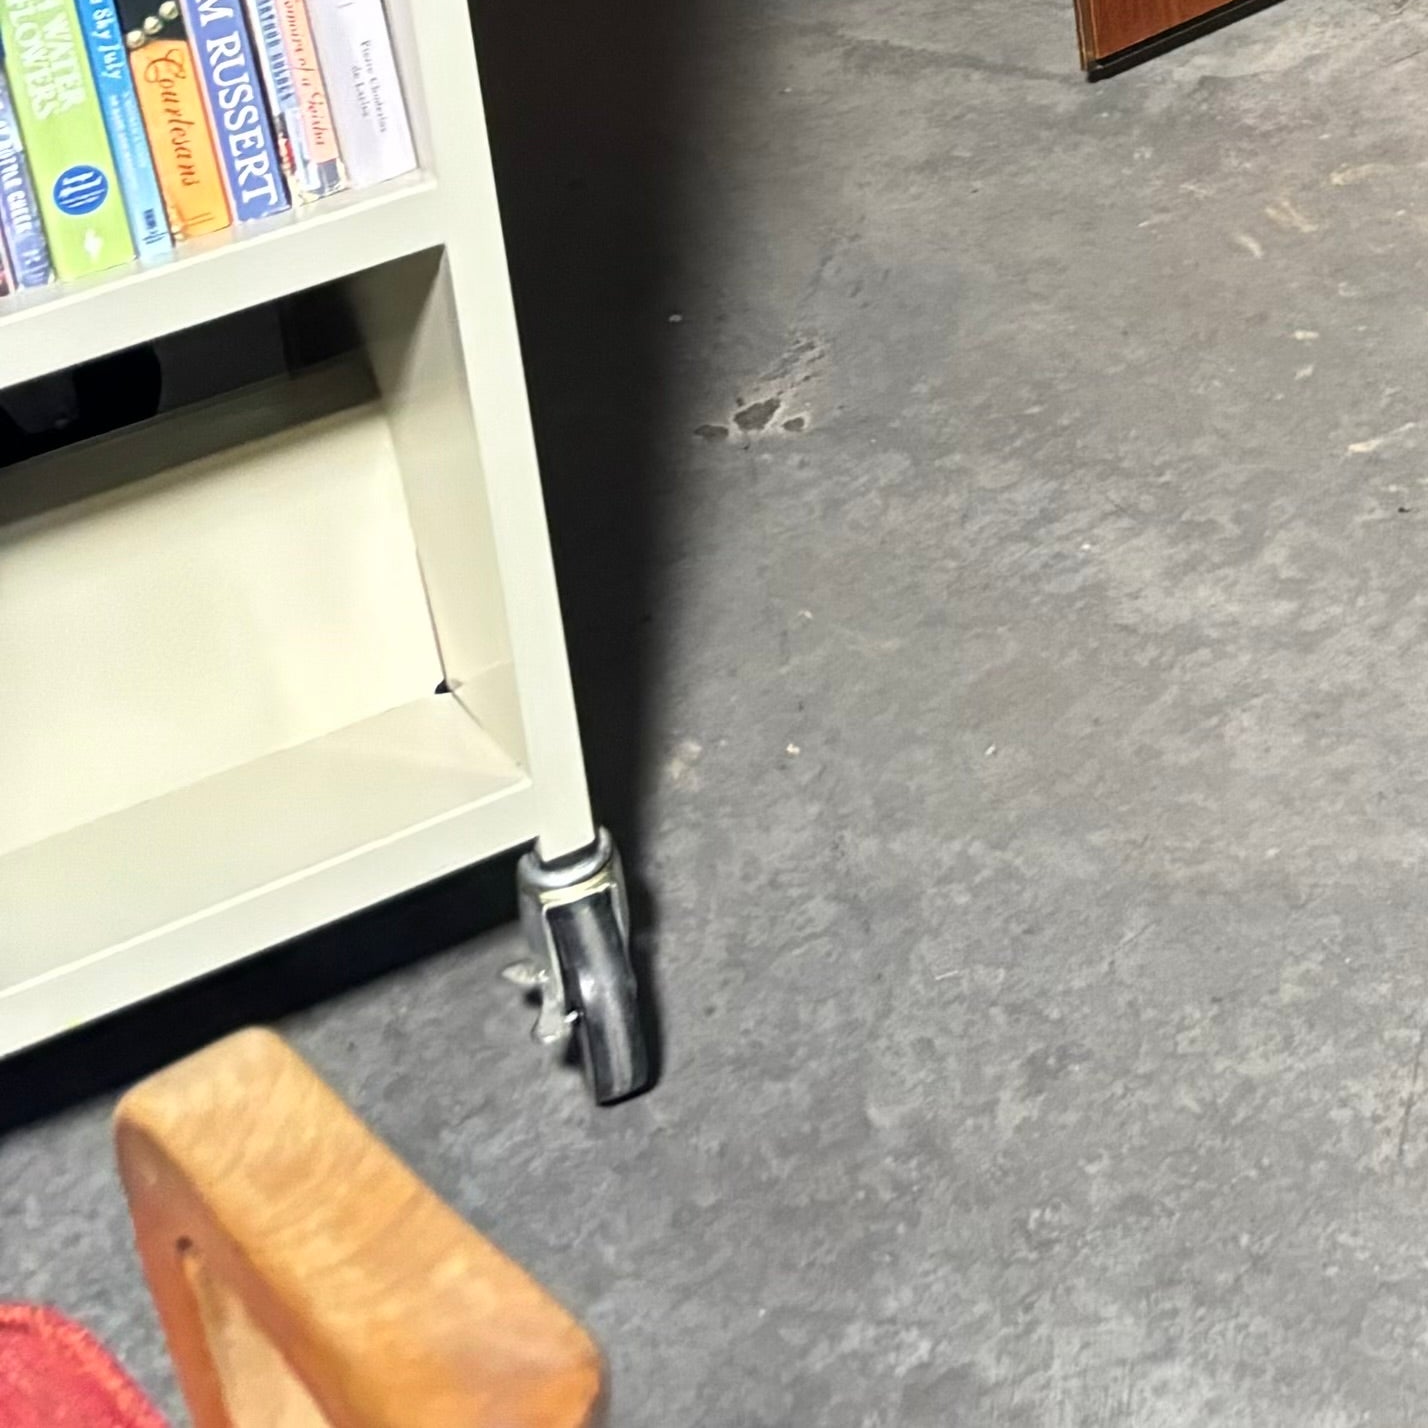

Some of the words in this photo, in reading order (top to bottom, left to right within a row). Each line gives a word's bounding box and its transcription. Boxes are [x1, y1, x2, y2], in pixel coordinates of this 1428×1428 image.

[42, 11, 86, 115] WATER
[92, 7, 113, 40] Sky
[98, 42, 123, 80] July
[144, 47, 201, 187] Courtesans
[206, 31, 279, 207] RUSSERT
